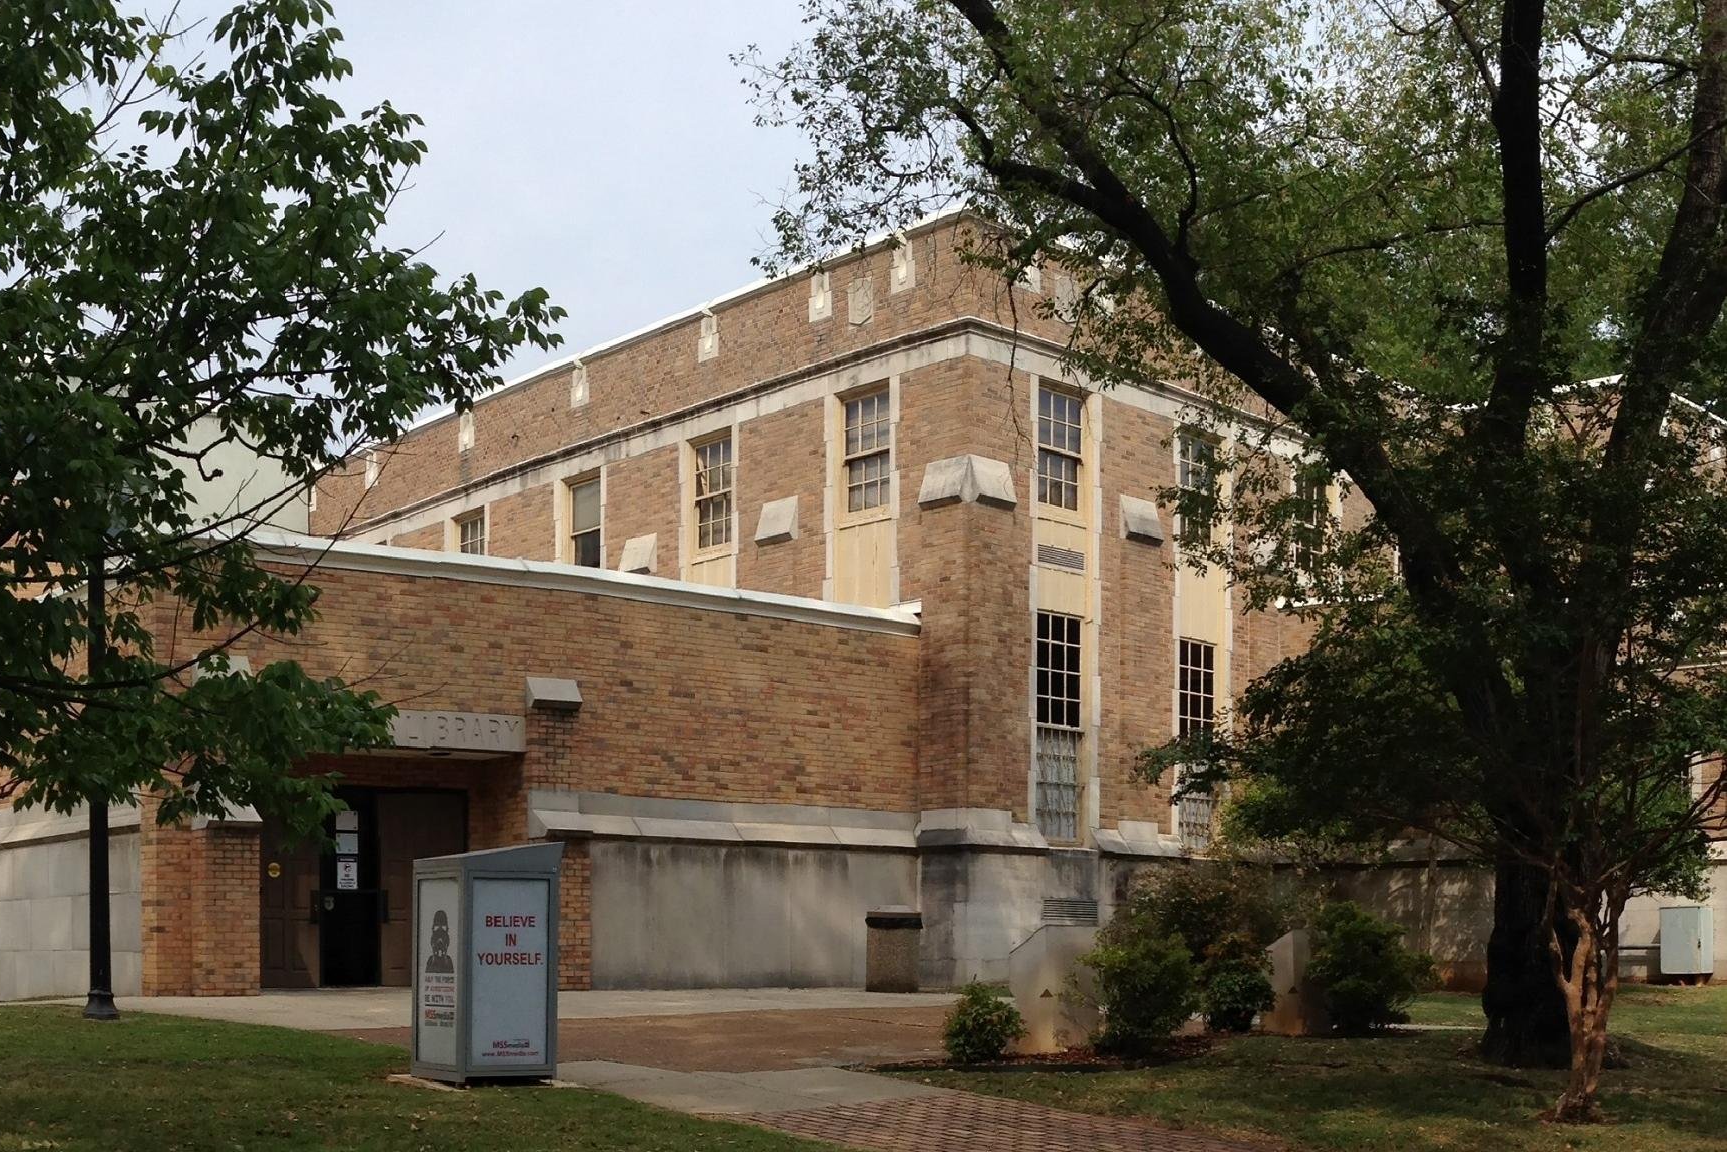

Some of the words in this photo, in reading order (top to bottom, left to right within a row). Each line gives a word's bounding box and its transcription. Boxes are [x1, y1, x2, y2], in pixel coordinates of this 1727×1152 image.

[405, 714, 520, 744] LIBRARY
[485, 915, 536, 928] BELIEVE
[505, 933, 517, 947] IN
[477, 952, 544, 966] YOURSELF.
